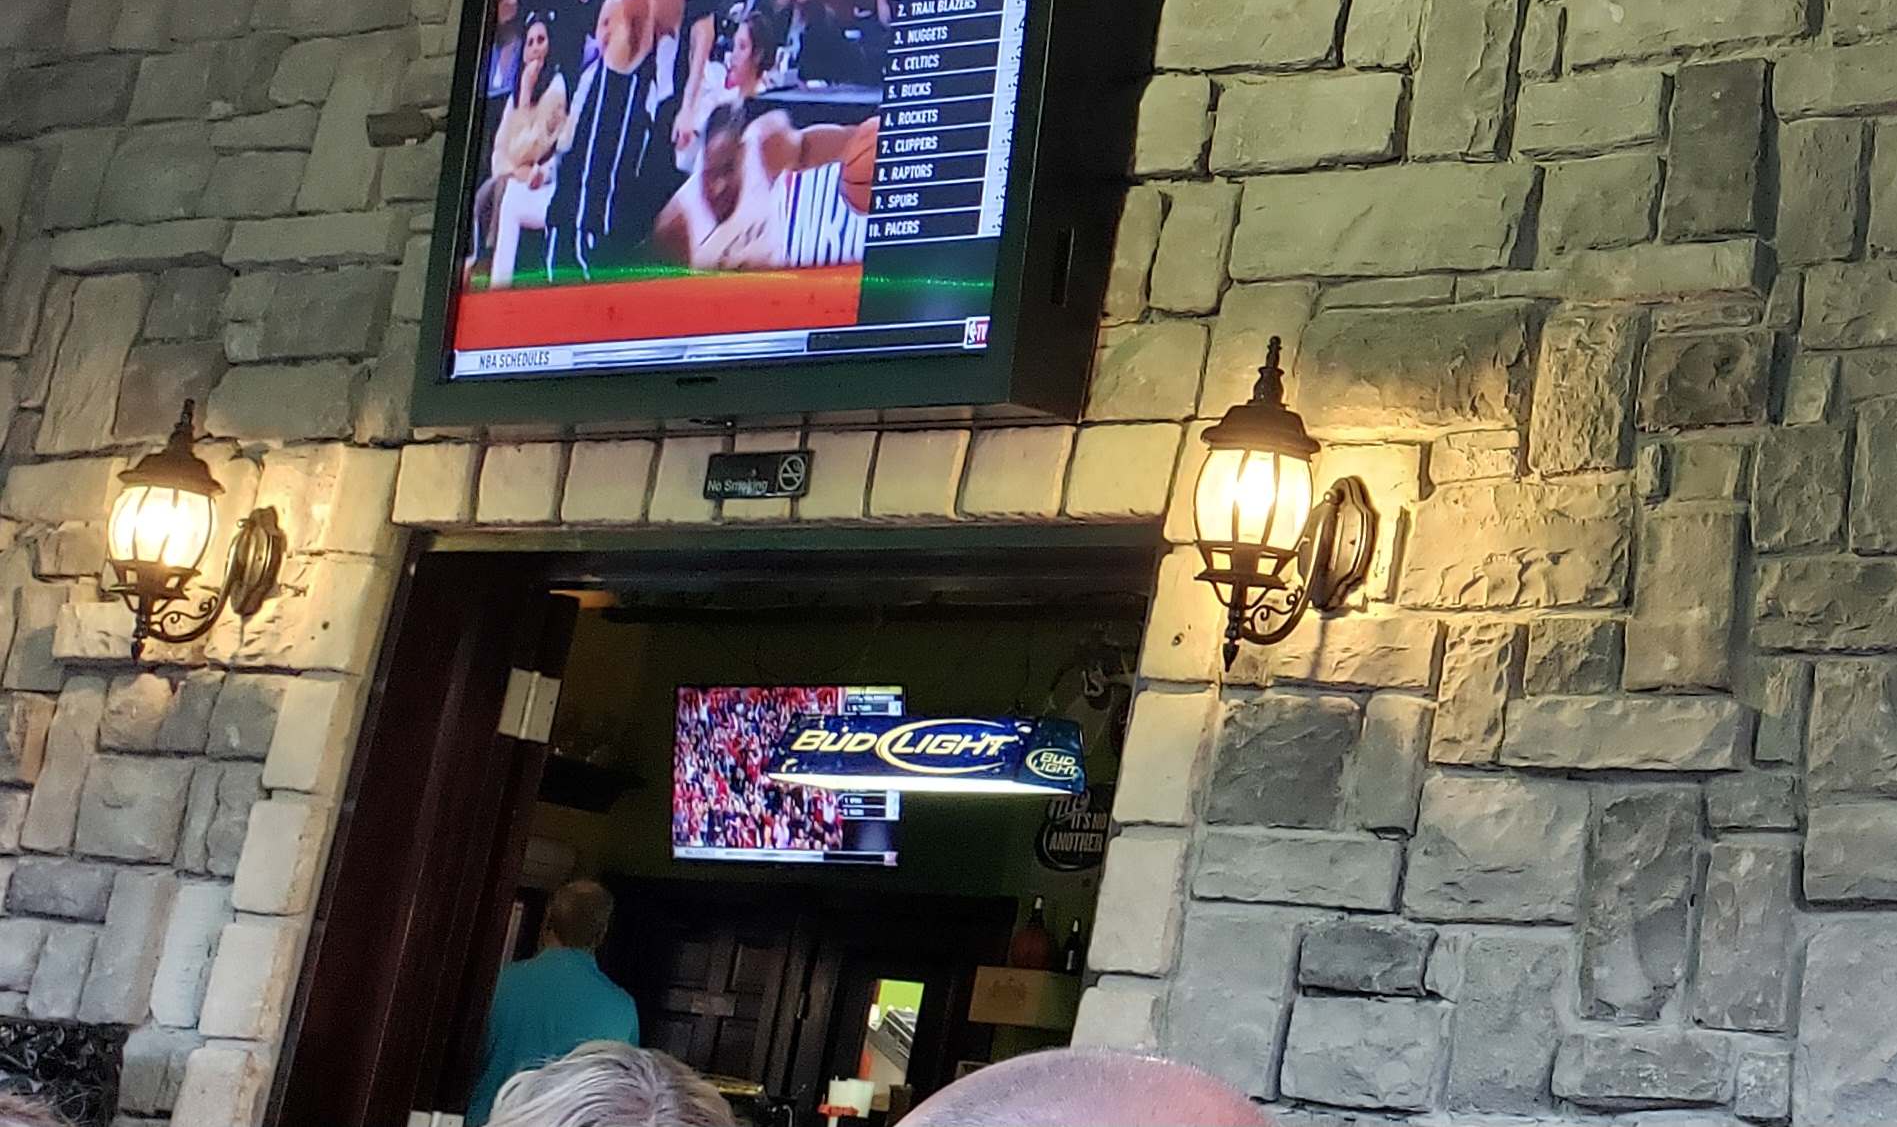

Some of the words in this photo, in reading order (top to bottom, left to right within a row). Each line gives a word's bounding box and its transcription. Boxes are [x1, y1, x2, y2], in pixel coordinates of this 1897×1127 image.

[897, 5, 907, 18] 2.
[911, 1, 935, 15] TRAIL
[907, 26, 949, 43] NUGGETS
[904, 54, 940, 70] CELTICS
[900, 82, 932, 98] BUCKS
[897, 109, 938, 125] ROCKETS
[881, 140, 891, 154] 7.
[894, 136, 938, 153] CLIPPERS
[891, 164, 933, 181] RAPTORS
[887, 193, 919, 209] SPURS
[884, 220, 920, 237] PACERS
[479, 355, 497, 369] NBA
[499, 351, 550, 368] SCHEDULES
[707, 479, 722, 492] No
[724, 479, 768, 494] Smoking
[790, 729, 878, 753] BUD
[891, 732, 1020, 758] LIGHT
[1039, 751, 1076, 766] BUD
[1033, 759, 1081, 778] LIGHT
[1048, 831, 1104, 853] ANOTHER
